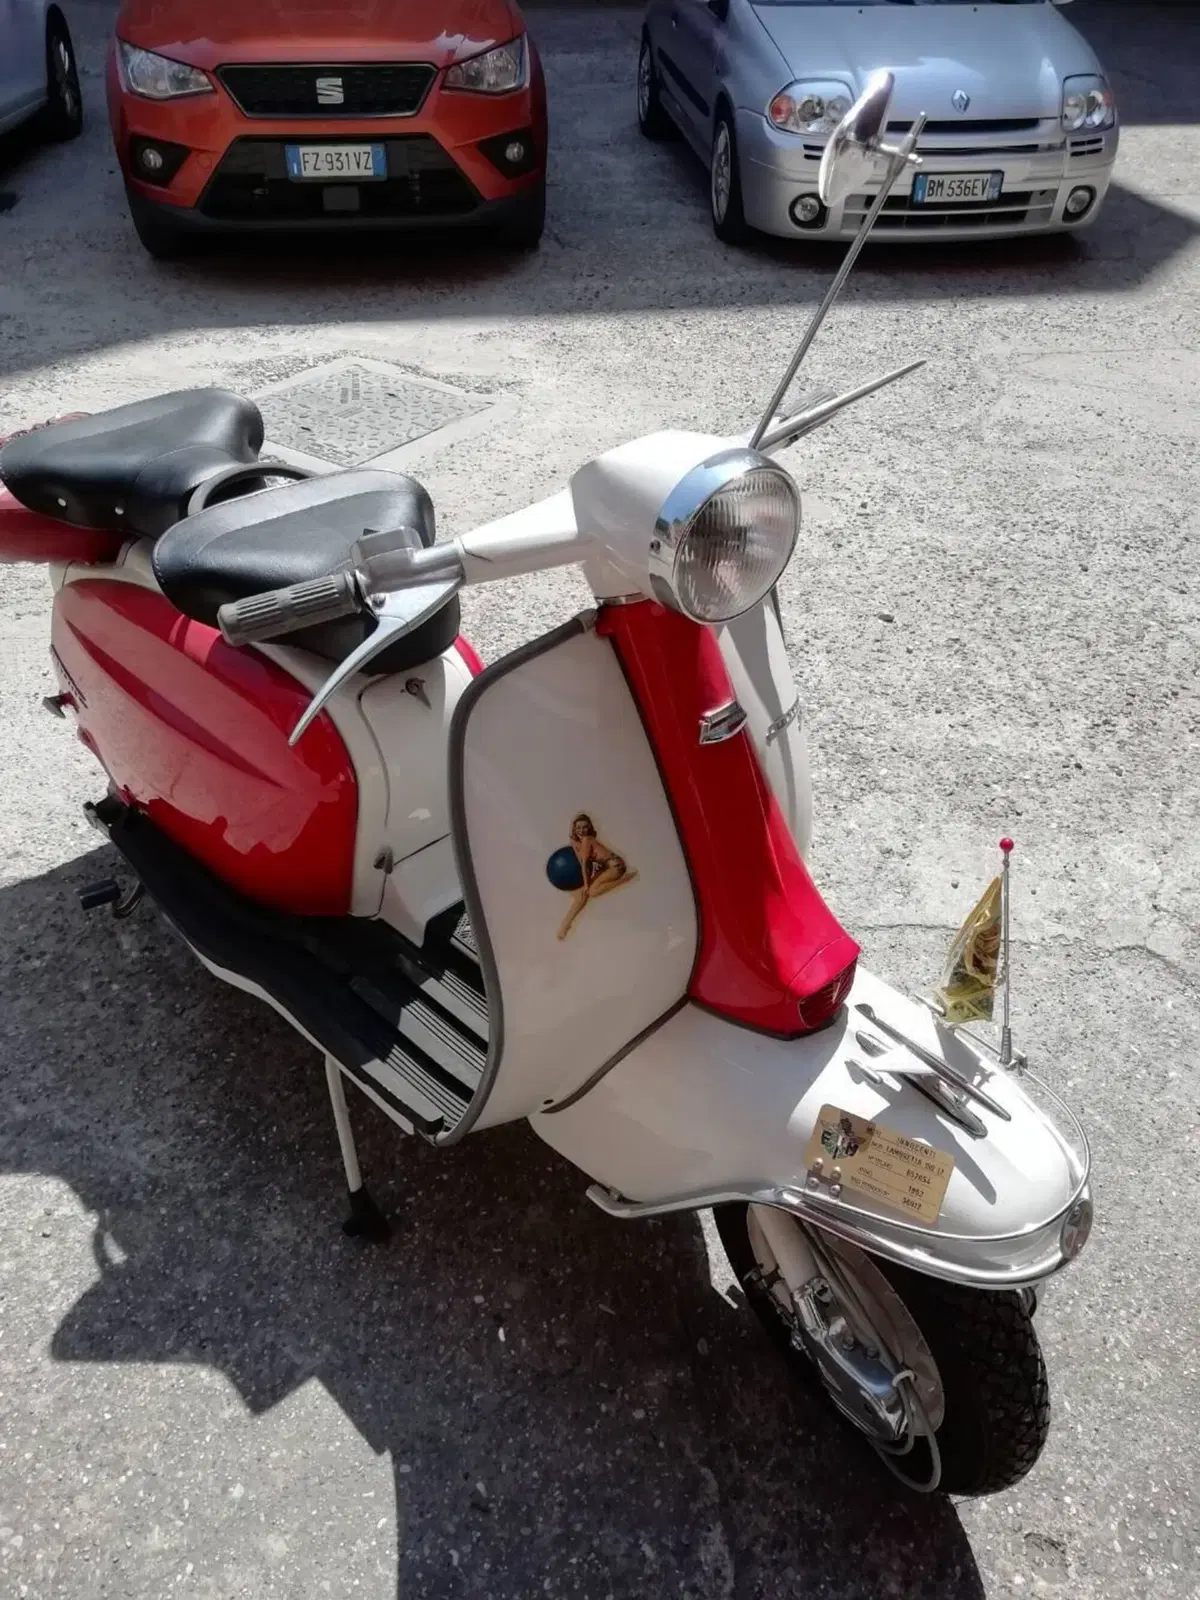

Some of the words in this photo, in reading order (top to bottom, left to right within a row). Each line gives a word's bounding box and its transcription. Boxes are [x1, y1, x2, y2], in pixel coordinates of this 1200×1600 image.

[302, 152, 321, 171] FZ
[325, 152, 372, 171] 931VZ
[927, 180, 945, 197] BM
[946, 179, 989, 197] 536EV
